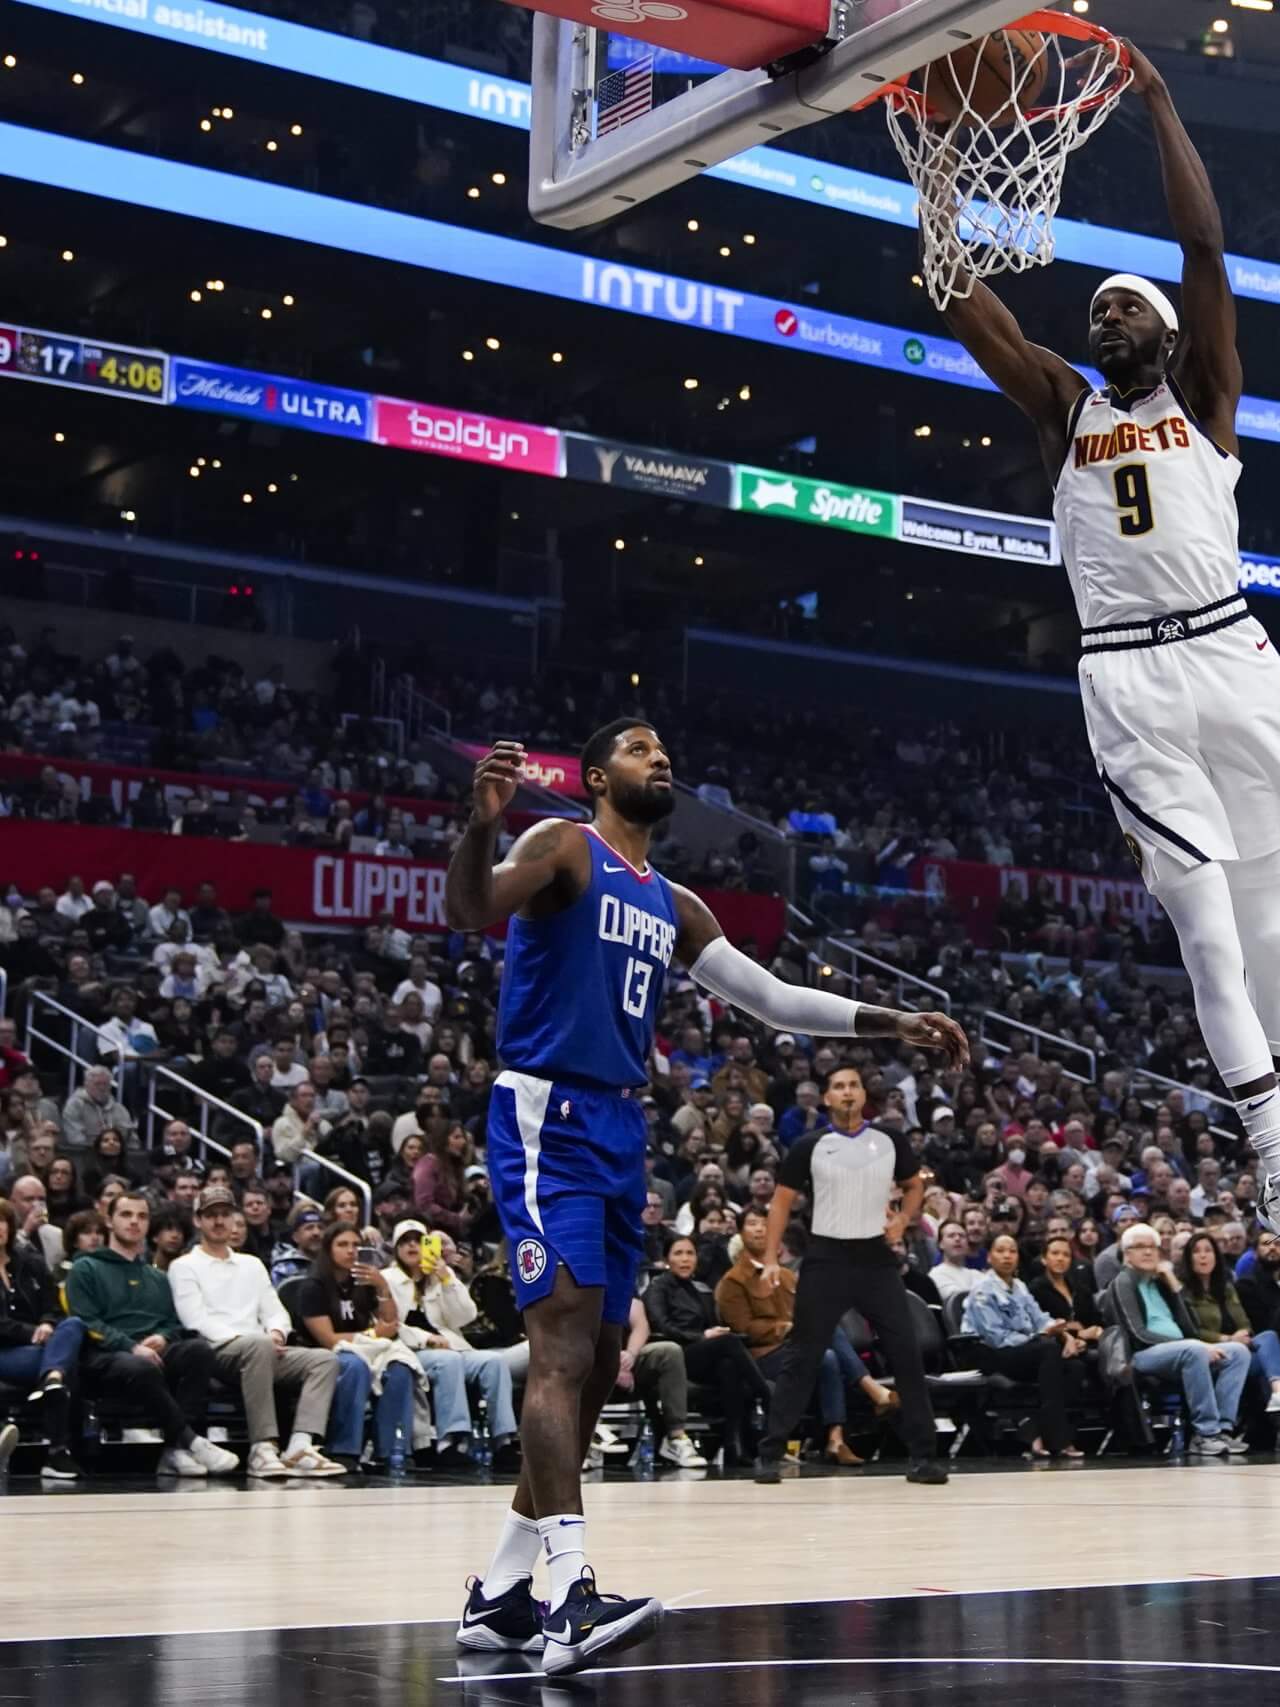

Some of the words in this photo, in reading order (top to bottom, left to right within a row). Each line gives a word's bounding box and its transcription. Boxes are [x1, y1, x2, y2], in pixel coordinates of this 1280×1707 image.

[154, 4, 267, 50] assistant
[469, 79, 531, 118] INT
[582, 263, 743, 330] INTUIT
[40, 346, 75, 375] 17
[800, 323, 883, 356] turbotax
[101, 356, 162, 392] 4:06
[282, 392, 362, 426] ULTRA
[408, 408, 528, 462] boldyn
[809, 488, 883, 524] Sprite
[1113, 463, 1154, 537] 9
[313, 855, 448, 928] CLIPPER
[599, 893, 676, 968] CLIPPERS
[622, 957, 653, 1019] 13
